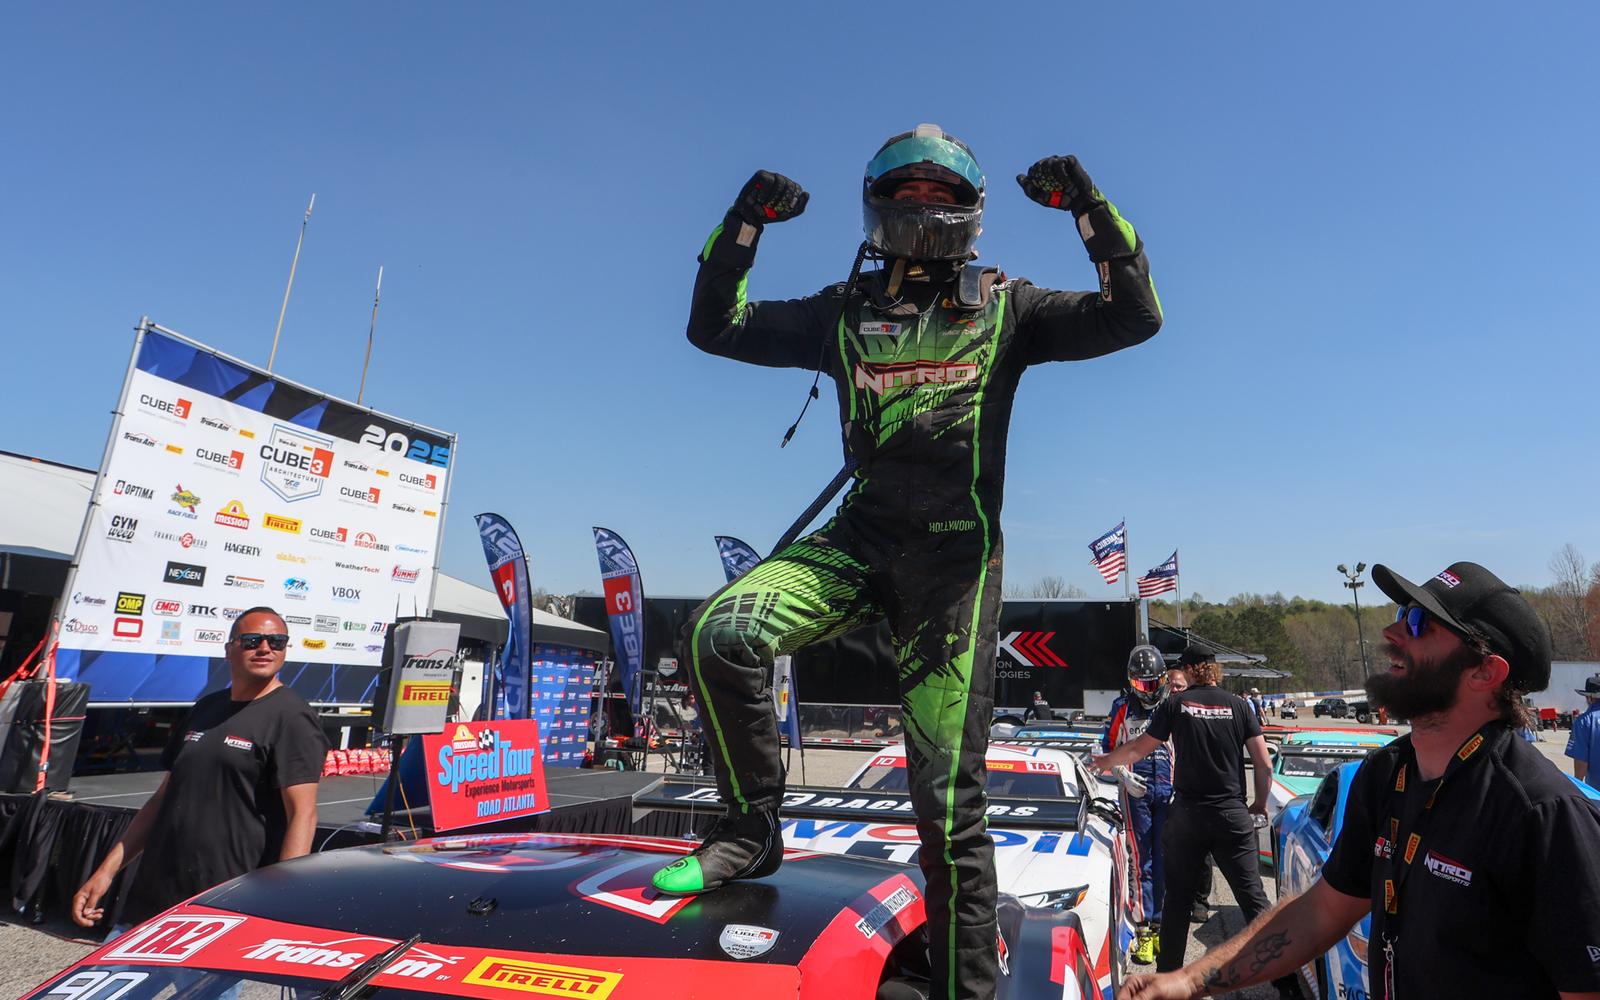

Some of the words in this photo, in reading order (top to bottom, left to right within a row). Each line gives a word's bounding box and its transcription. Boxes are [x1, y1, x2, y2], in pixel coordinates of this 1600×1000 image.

[855, 363, 977, 396] NITRO
[140, 394, 192, 419] CUBE3
[359, 424, 450, 468] 2025
[196, 448, 244, 470] CUBE3
[260, 445, 334, 478] CUBE3
[269, 466, 318, 483] ARCHITECTURE
[399, 473, 437, 489] CUBE3
[125, 484, 154, 500] OPTIMA
[340, 487, 380, 504] CUBE3
[111, 516, 138, 531] GYM
[265, 516, 299, 532] PIRELLI
[929, 520, 976, 533] HOLLYWOOD
[310, 527, 348, 543] CUBE3
[224, 541, 262, 557] HAGERTY
[168, 567, 202, 581] NEXGEN
[335, 561, 381, 574] WeatherTech
[332, 586, 361, 600] VBOX
[117, 597, 143, 610] OMP
[155, 600, 181, 612] EMCO
[74, 620, 98, 632] Duco
[198, 631, 222, 642] MoTeC
[1181, 704, 1233, 717] NITRO
[224, 736, 253, 749] NITRO
[876, 756, 895, 766] 10
[1030, 762, 1056, 771] TA2
[465, 781, 500, 799] Experience
[501, 778, 535, 792] Motorsports
[477, 798, 501, 817] ROAD
[502, 793, 535, 813] ATLANTA
[1424, 852, 1473, 882] NITRO
[124, 920, 226, 956] TA2
[242, 938, 365, 968] Trans
[725, 946, 760, 954] AWARD
[480, 962, 607, 994] PIRELLI
